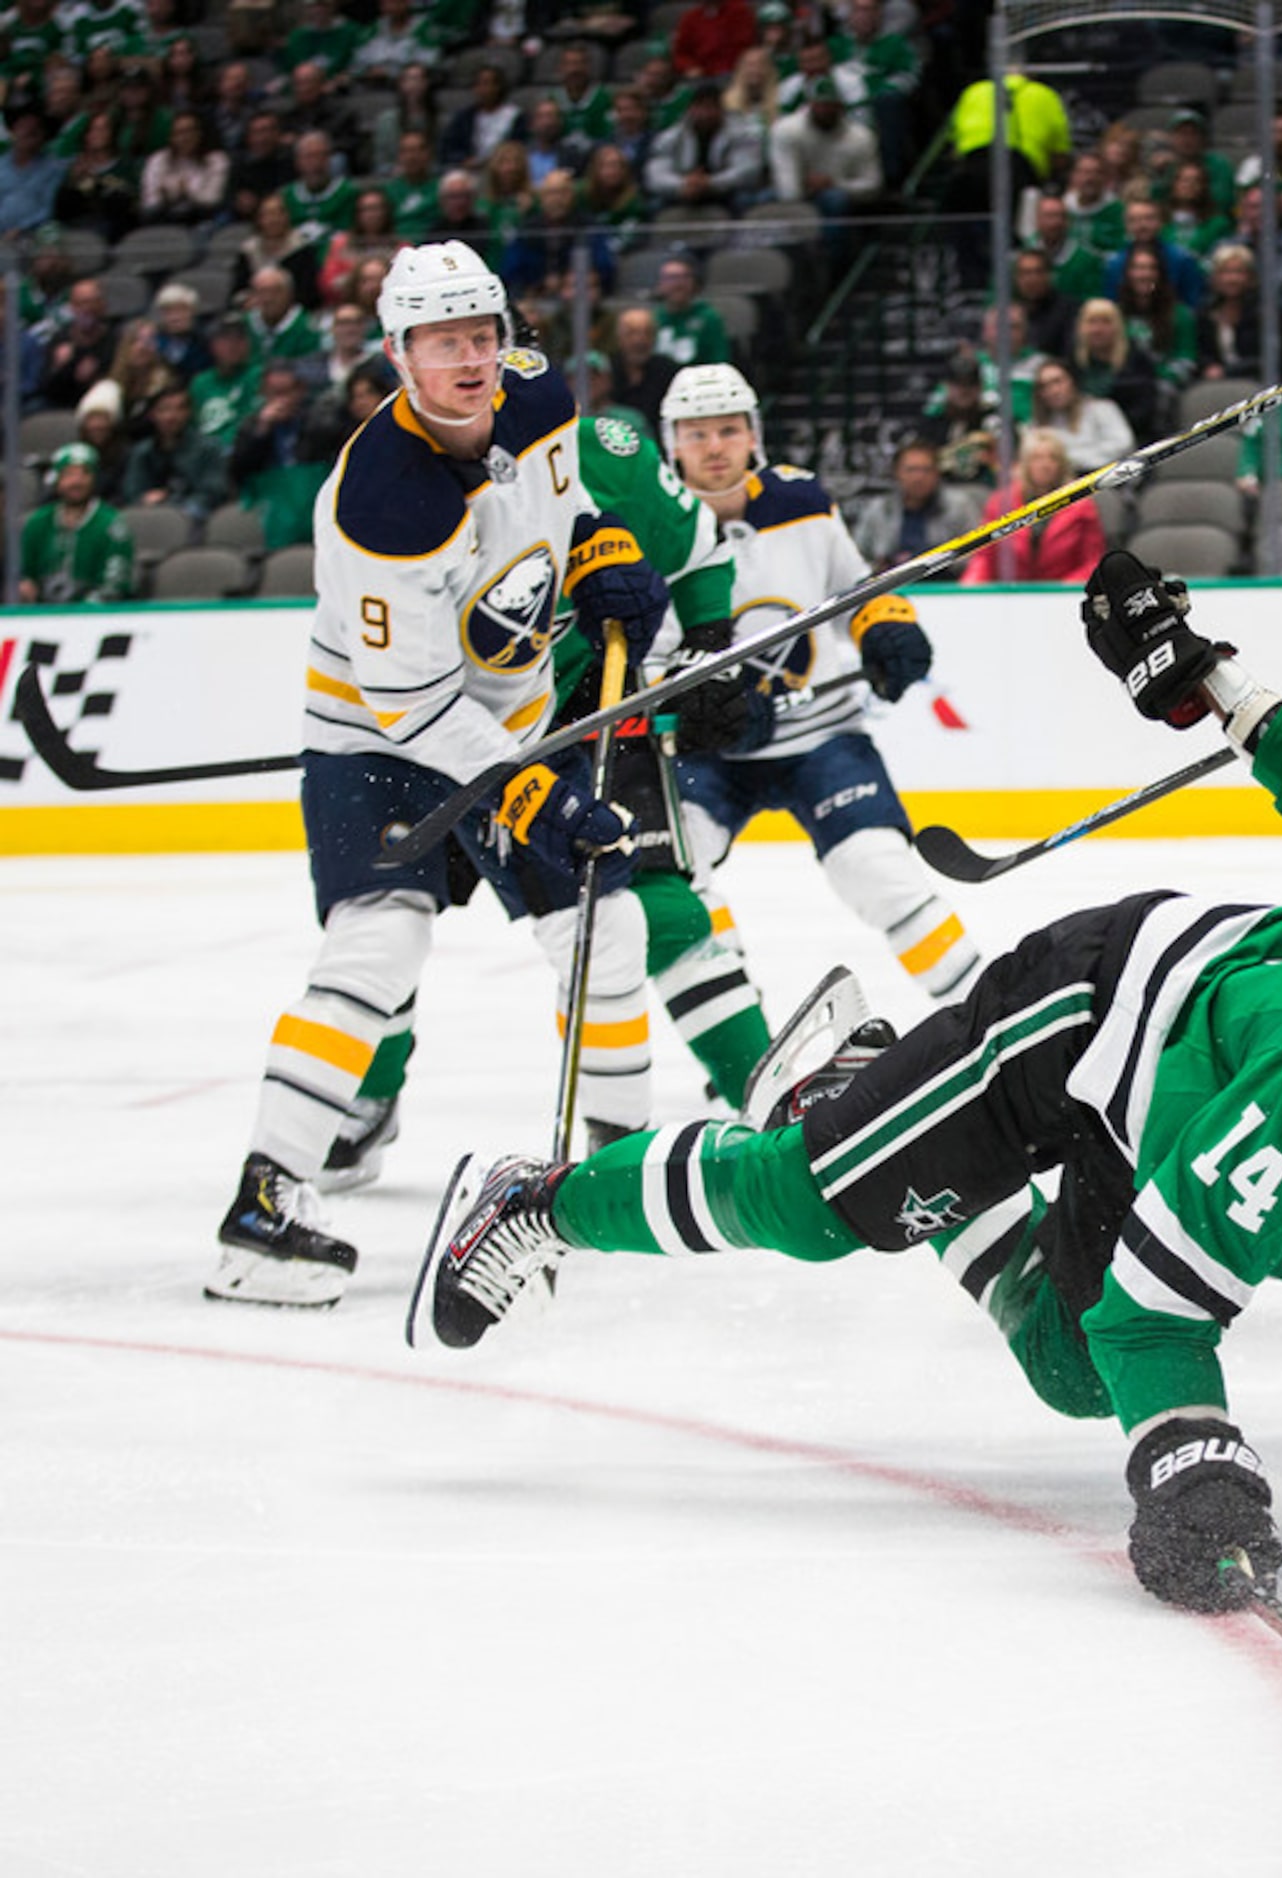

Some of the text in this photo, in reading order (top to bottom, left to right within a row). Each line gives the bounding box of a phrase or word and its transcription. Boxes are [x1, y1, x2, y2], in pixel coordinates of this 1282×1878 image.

[547, 442, 570, 497] C
[361, 594, 391, 651] 9
[813, 782, 878, 821] CCM
